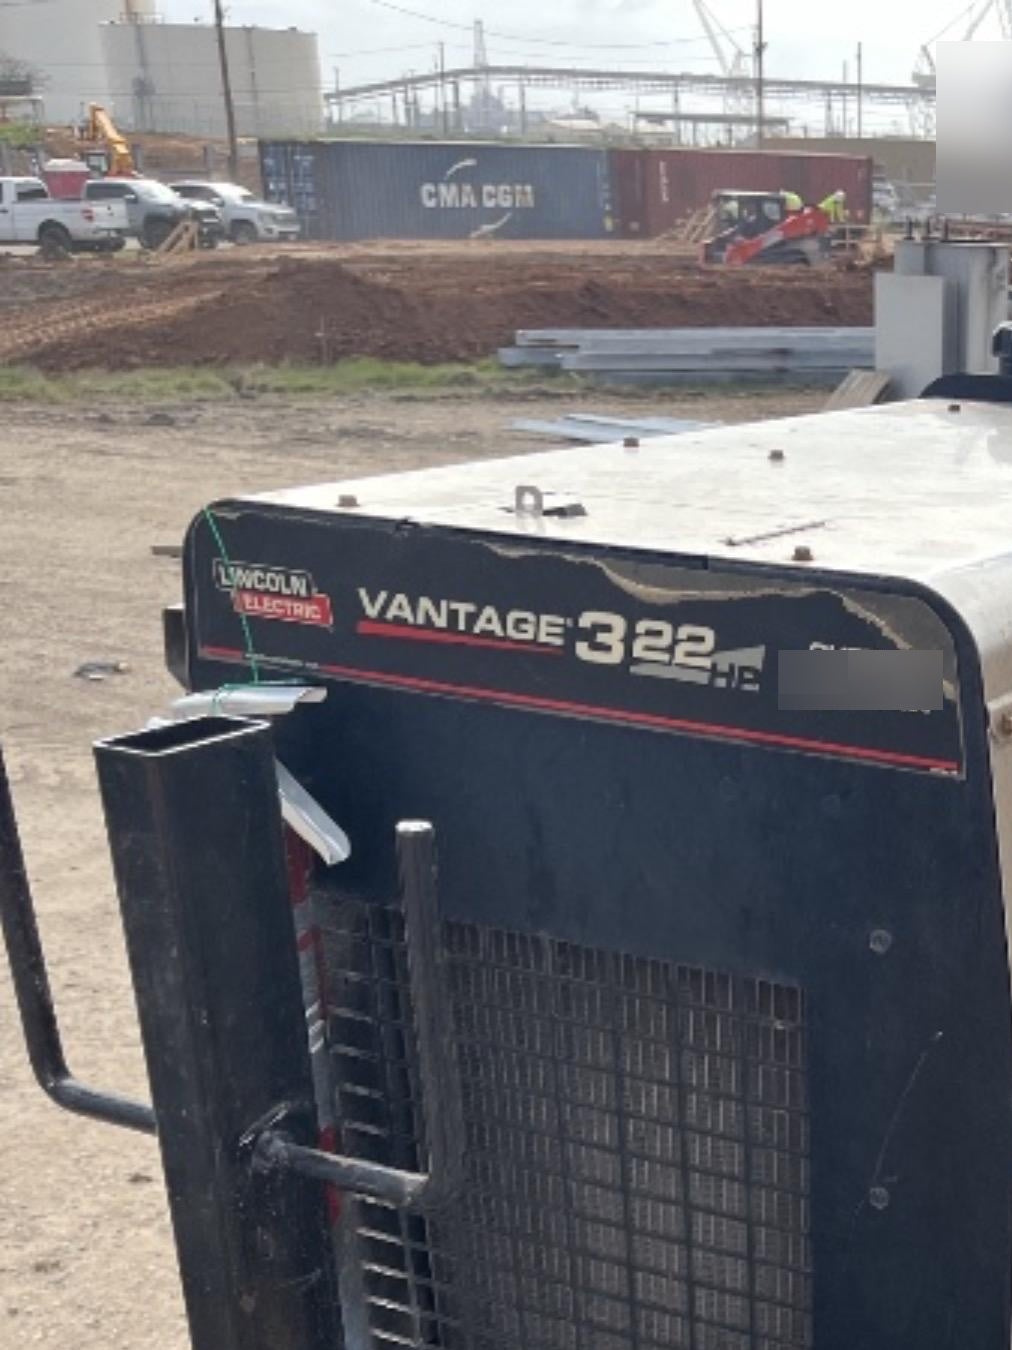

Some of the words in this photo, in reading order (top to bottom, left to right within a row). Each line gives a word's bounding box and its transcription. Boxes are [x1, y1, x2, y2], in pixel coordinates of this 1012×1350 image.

[421, 182, 478, 208] CMA
[481, 184, 535, 208] CGM
[218, 565, 308, 597] LINCOLN
[243, 594, 322, 620] ELECTRIC
[357, 587, 565, 646] VANTAGE
[575, 611, 715, 670] 322
